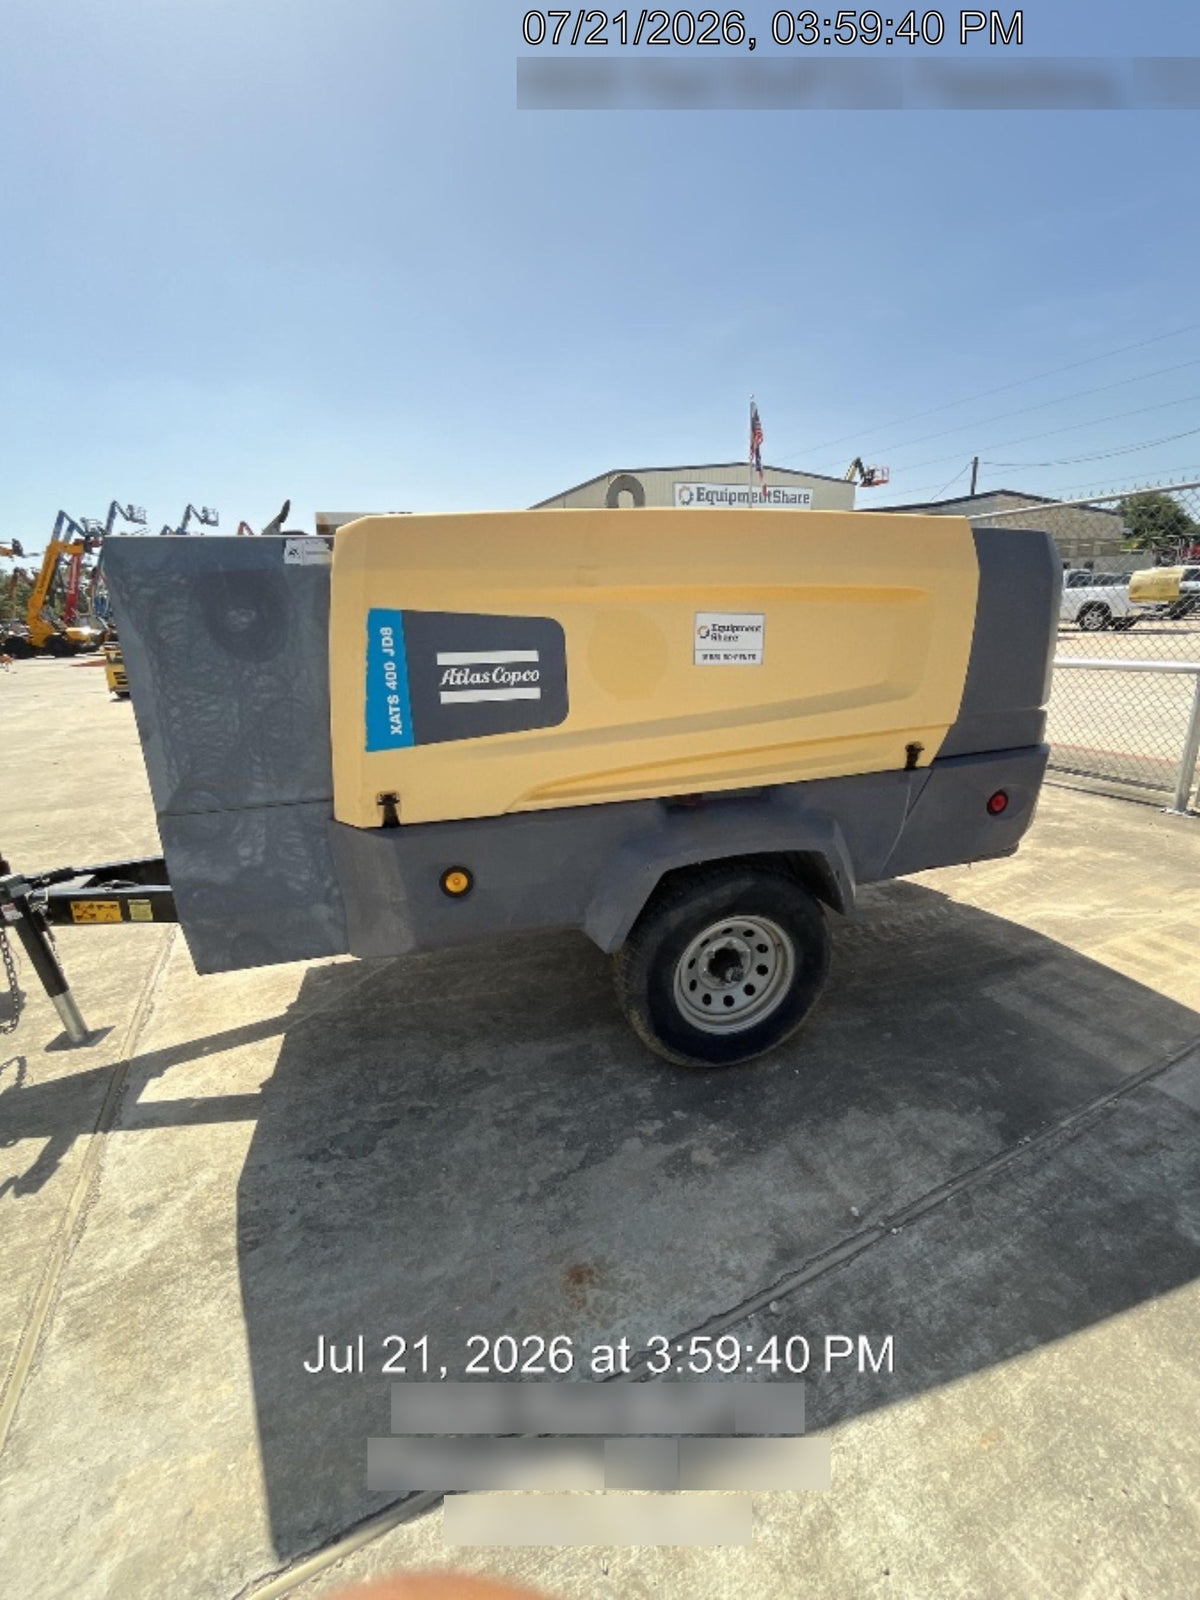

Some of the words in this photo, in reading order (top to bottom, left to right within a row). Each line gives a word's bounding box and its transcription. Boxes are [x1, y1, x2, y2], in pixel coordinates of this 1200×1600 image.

[380, 626, 396, 657] JD8
[384, 661, 398, 691] 400
[440, 667, 490, 686] Atlas
[491, 666, 540, 686] Copco
[387, 694, 402, 735] XATS
